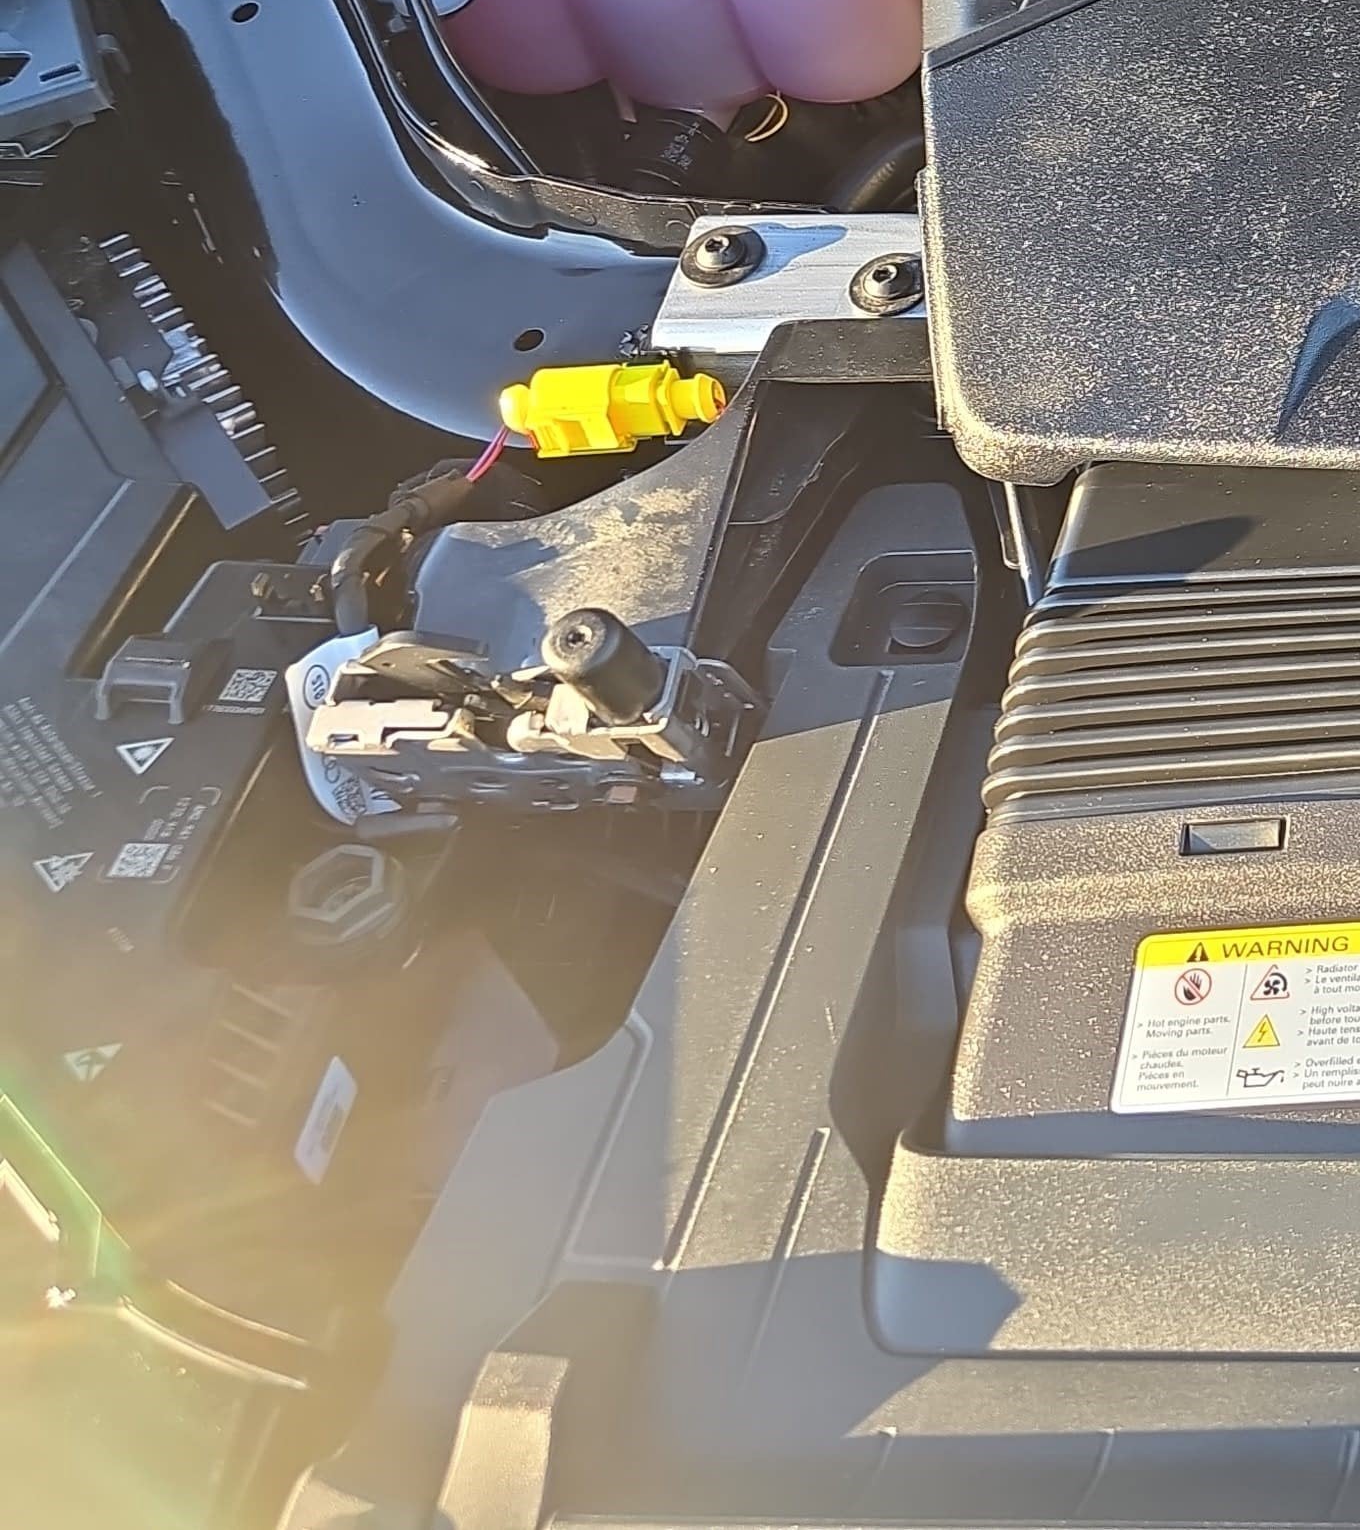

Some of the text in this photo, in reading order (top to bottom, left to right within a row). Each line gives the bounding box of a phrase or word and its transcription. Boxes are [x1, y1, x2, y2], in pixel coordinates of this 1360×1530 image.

[1220, 936, 1349, 958] WARNING
[1316, 963, 1358, 973] Radiator
[1315, 975, 1327, 983] Le
[1313, 985, 1320, 994] à
[1321, 984, 1341, 993] tout
[1310, 1004, 1334, 1016] High
[1147, 1015, 1231, 1028] Hot engine parts.
[1309, 1015, 1341, 1024] before
[1145, 1027, 1211, 1040] Moving parts.
[1308, 1025, 1337, 1035] Haute
[1306, 1037, 1334, 1046] avant
[1336, 1036, 1349, 1044] de
[1176, 1048, 1189, 1057] du
[1191, 1047, 1227, 1056] moteur
[1304, 1056, 1354, 1067] Overfilled
[1303, 1068, 1318, 1077] Un
[1136, 1080, 1199, 1091] mouvement.
[1302, 1080, 1324, 1089] peut
[1327, 1078, 1353, 1086] nuire
